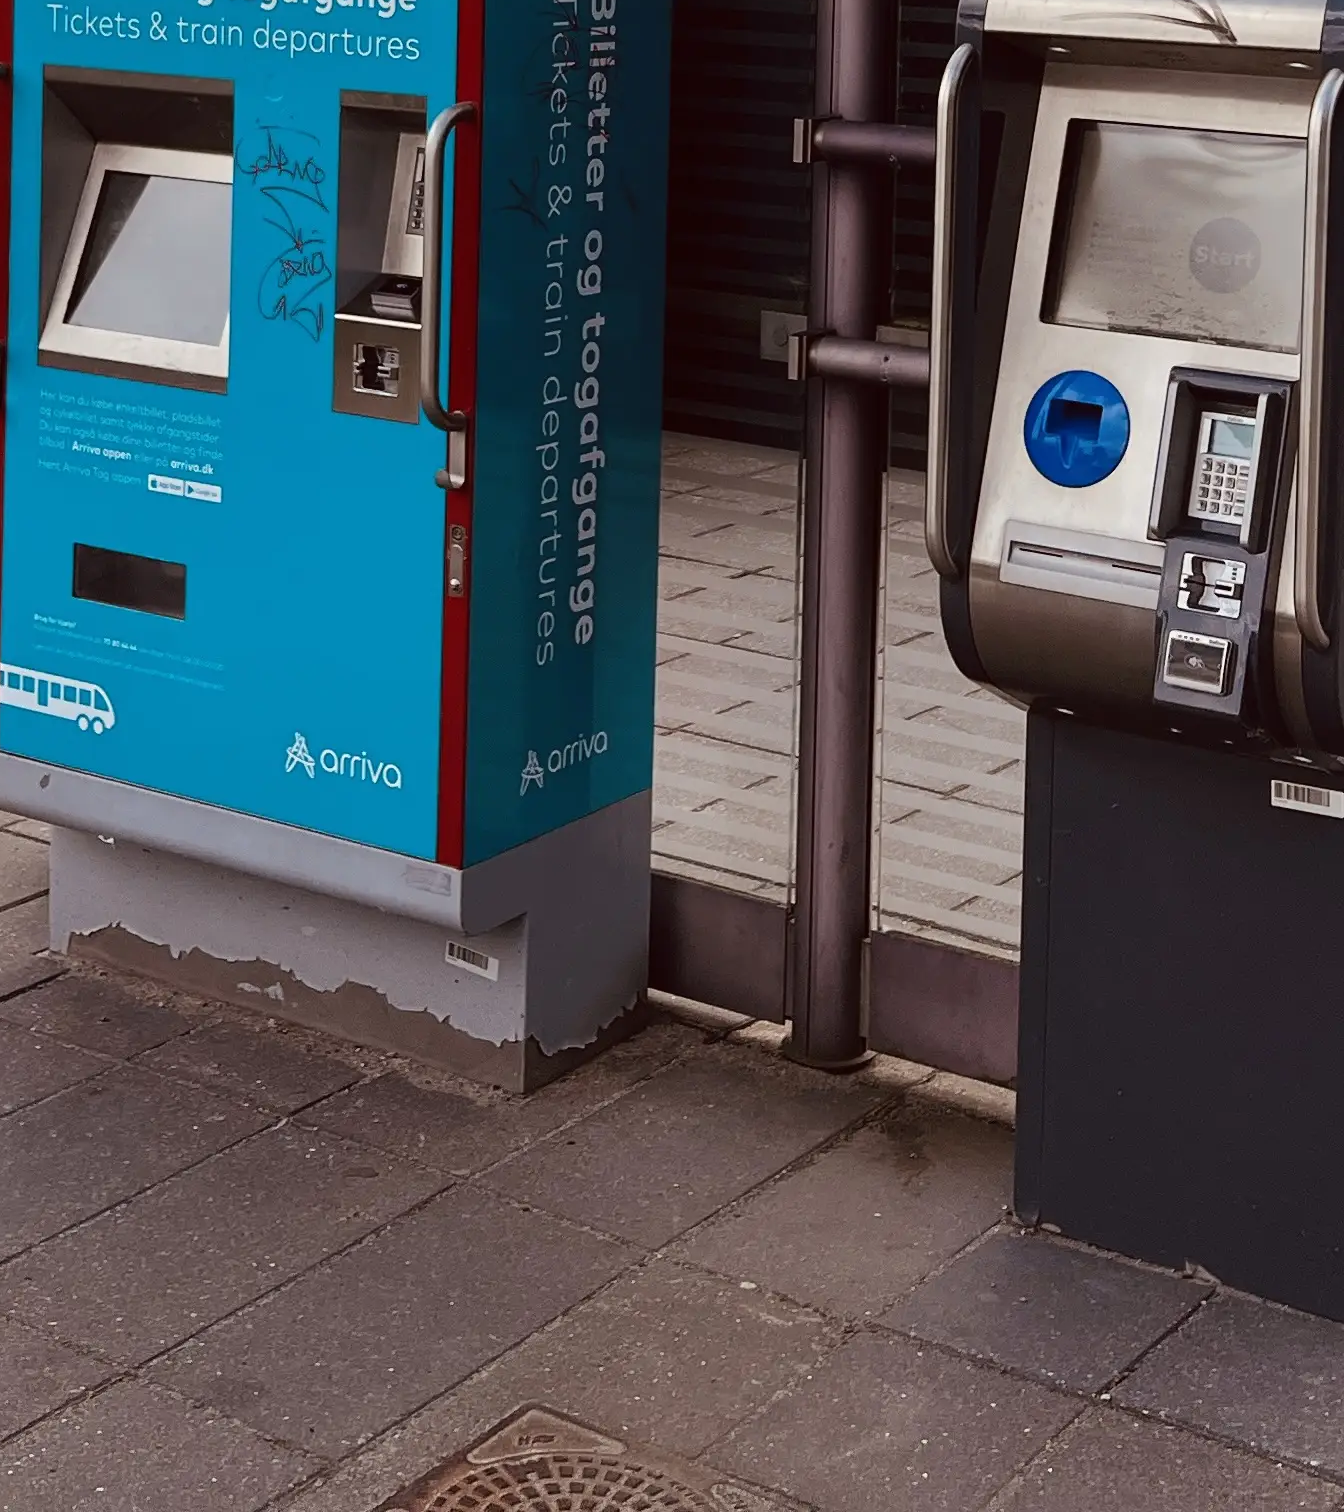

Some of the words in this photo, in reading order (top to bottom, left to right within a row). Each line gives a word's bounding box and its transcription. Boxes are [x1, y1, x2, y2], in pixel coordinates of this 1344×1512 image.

[46, 3, 140, 40] Tickets
[149, 11, 168, 42] &
[177, 17, 243, 47] train
[253, 19, 420, 61] departures
[547, 184, 573, 218] &
[576, 229, 604, 297] og
[1195, 246, 1255, 268] Start
[543, 233, 569, 357] train
[39, 407, 52, 419] og
[100, 415, 125, 429] samt
[156, 422, 219, 444] afgangstider
[58, 390, 76, 404] kan
[77, 394, 89, 407] du
[171, 409, 222, 429] pladsbillet
[39, 419, 52, 432] Du
[54, 422, 71, 435] kan
[72, 425, 95, 440] også
[183, 445, 196, 459] og
[198, 445, 224, 461] finde
[71, 440, 101, 456] Arriva
[102, 447, 132, 461] appen
[170, 459, 214, 476] arriva.dk
[62, 460, 91, 477] Arriva
[93, 465, 110, 481] Tog
[111, 473, 142, 486] appen
[568, 311, 606, 645] togafgange
[535, 376, 568, 666] departures
[319, 750, 402, 789] arriva
[547, 731, 609, 774] arriva
